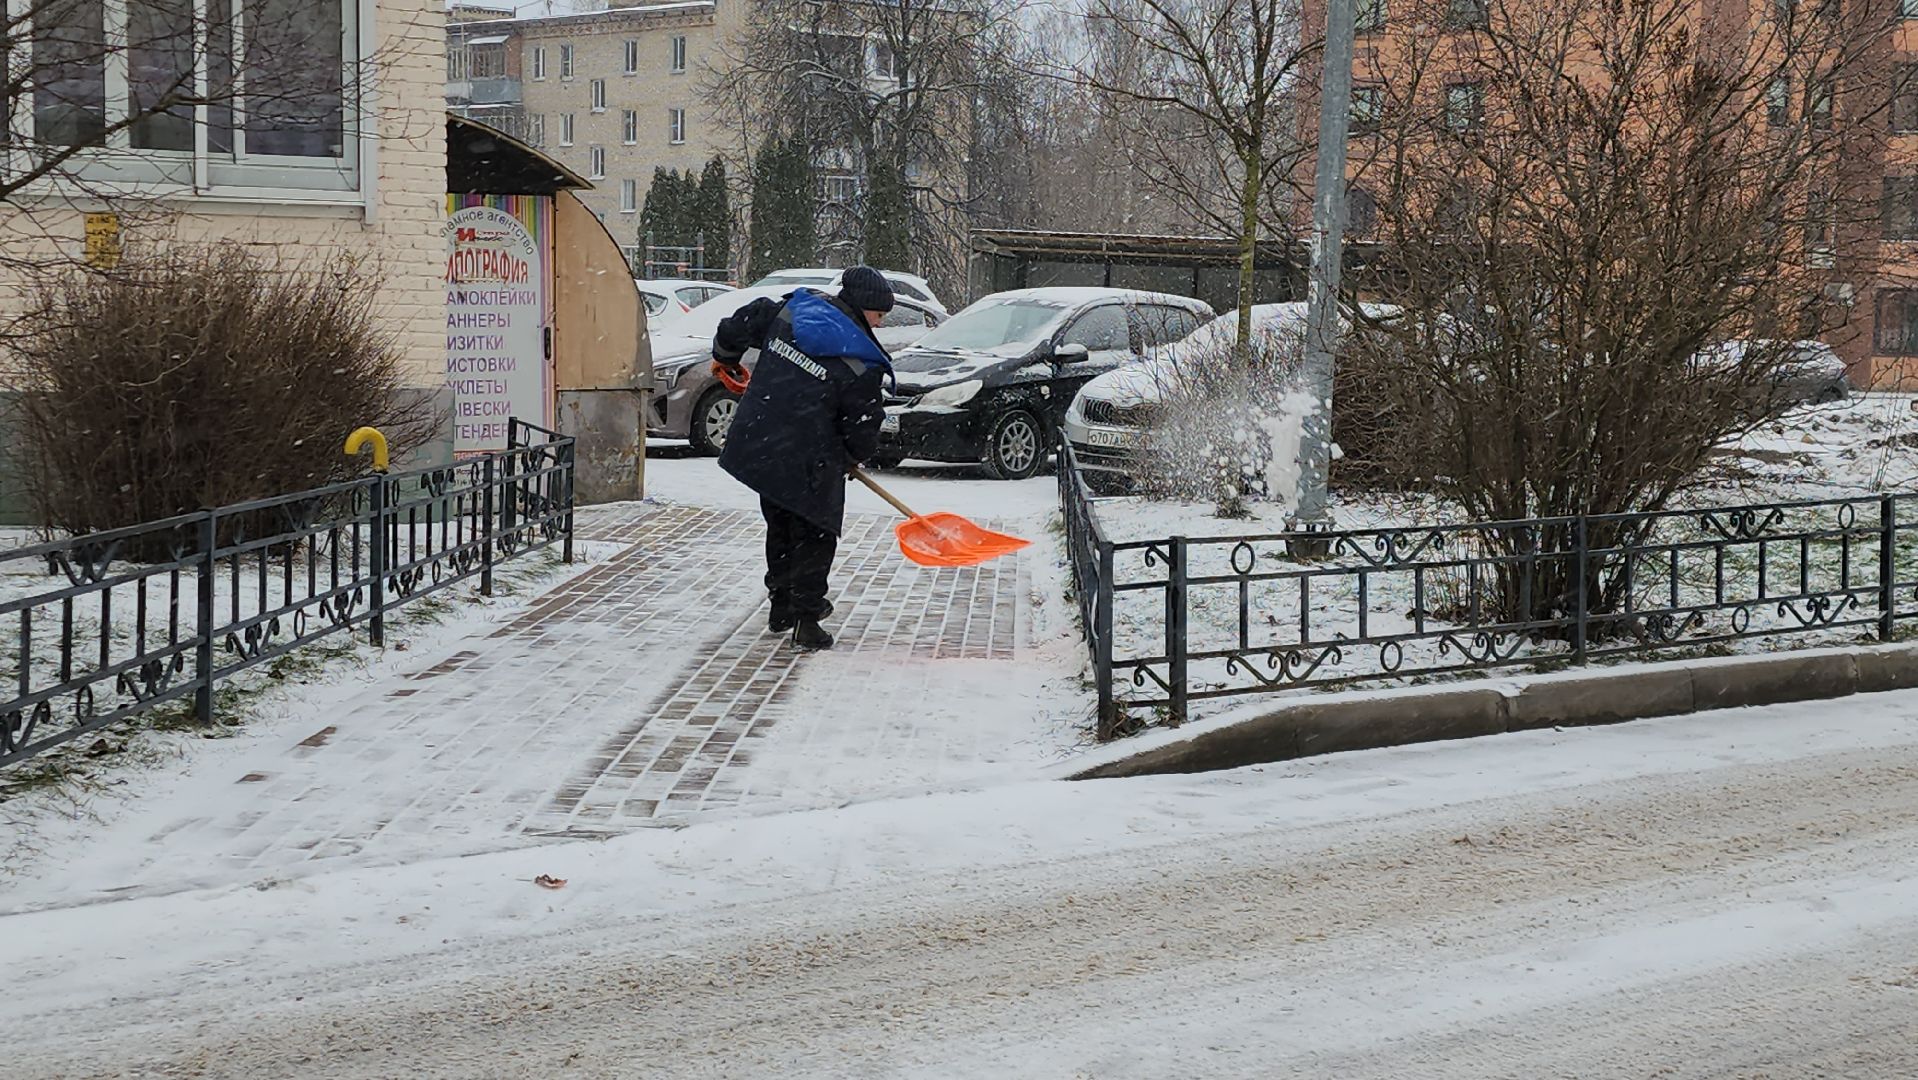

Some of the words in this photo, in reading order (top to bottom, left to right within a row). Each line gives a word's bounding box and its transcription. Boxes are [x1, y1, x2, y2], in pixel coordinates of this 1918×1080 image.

[440, 210, 483, 239] ламное
[487, 211, 535, 256] агентство
[445, 247, 529, 285] ИПОГРАФИЯ
[446, 287, 536, 306] АМОКЛЕЙКИ
[446, 313, 511, 328] АННЕРЫ
[447, 335, 504, 350] ИЗИТКИ
[447, 357, 516, 373] ИСТОВКИ
[448, 379, 508, 395] УКЛЕТЫ
[454, 423, 509, 440] ТЕНДЕР
